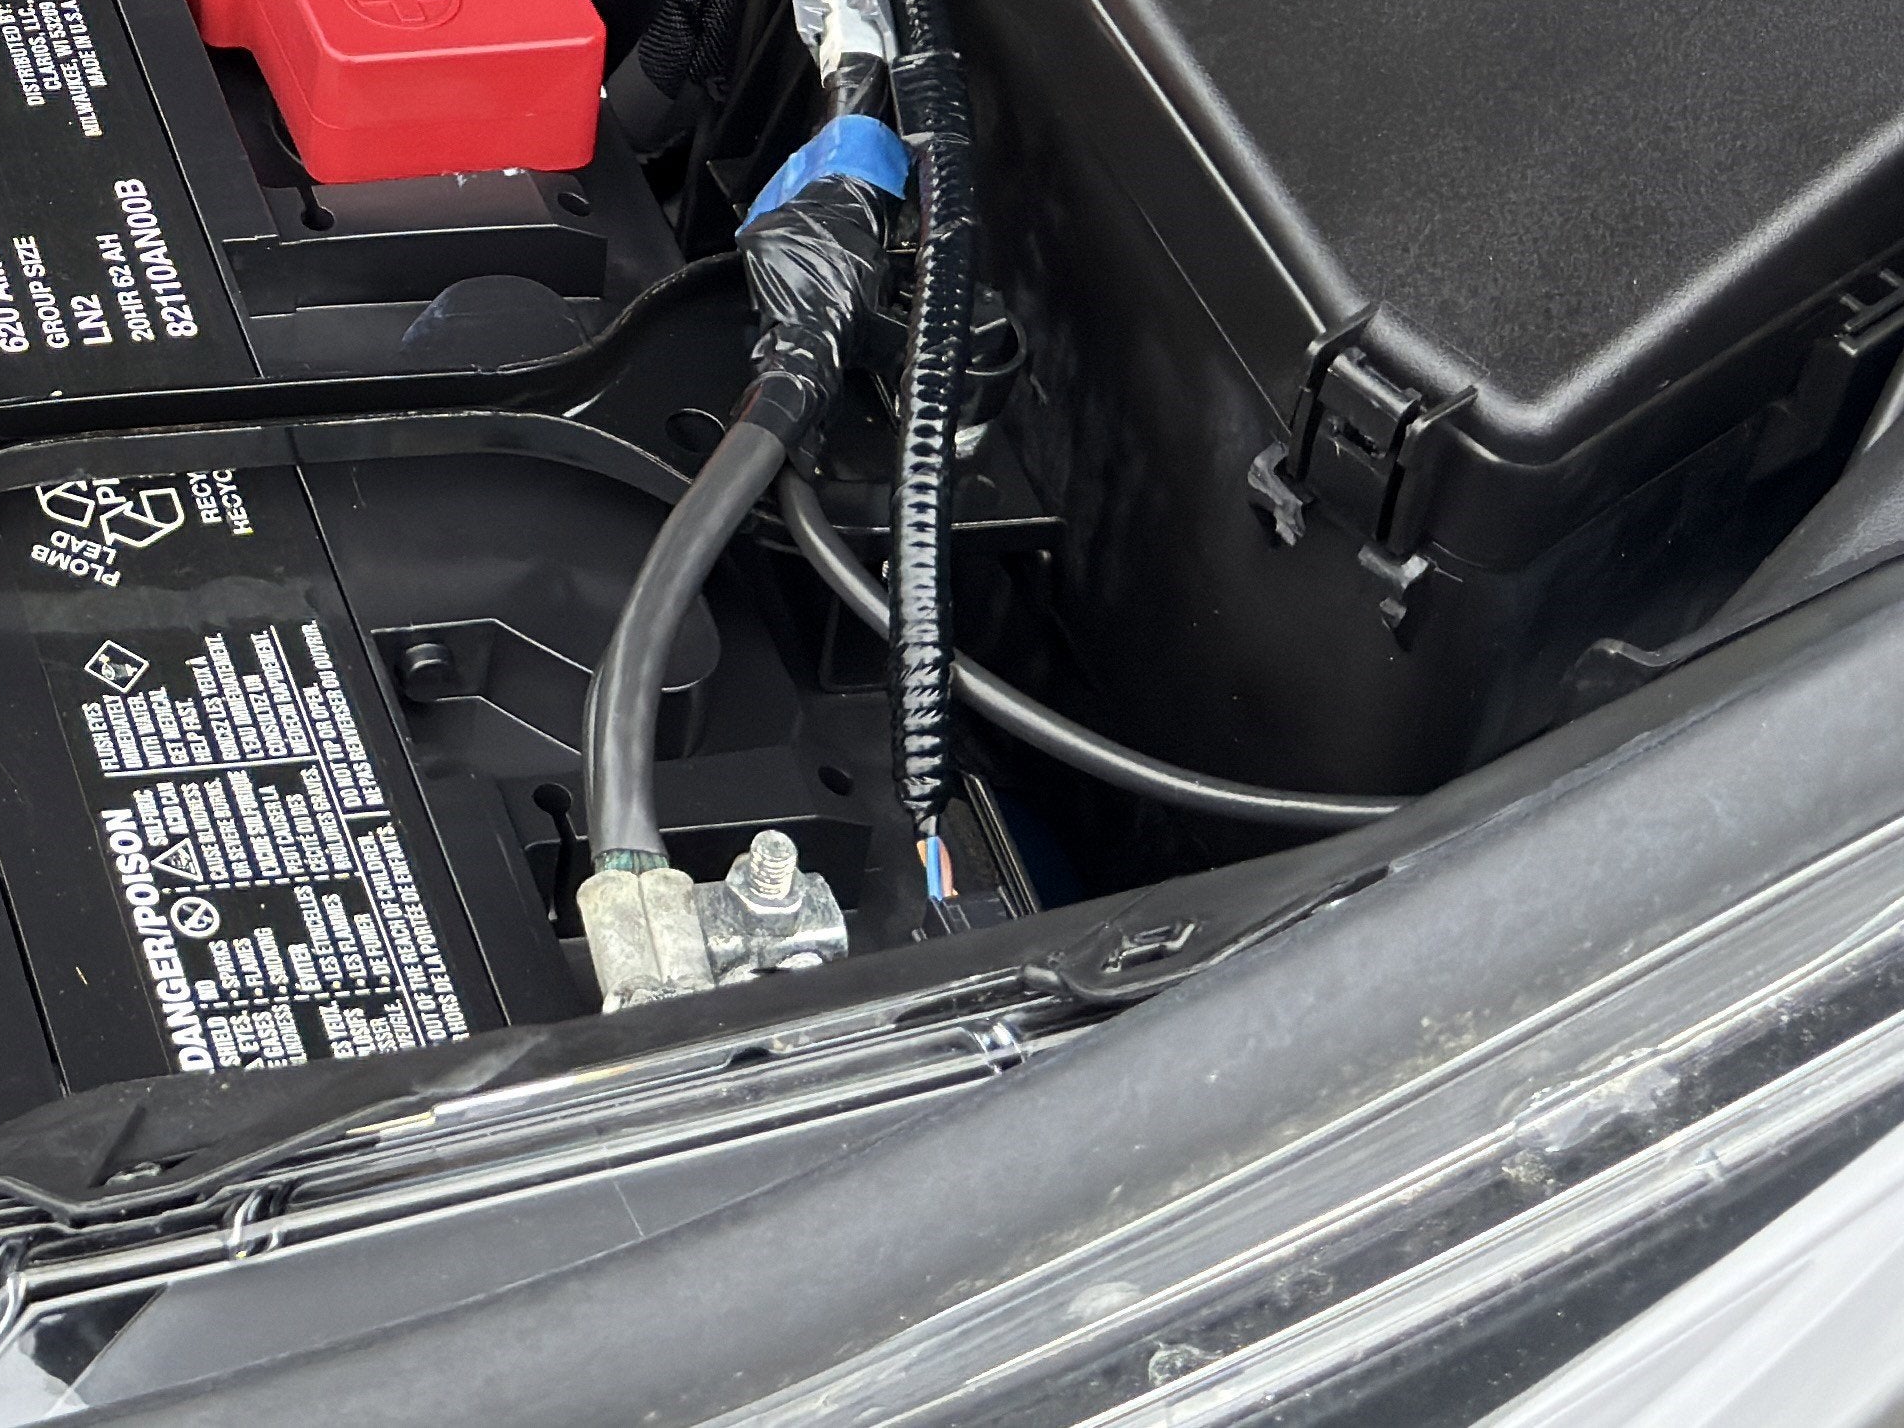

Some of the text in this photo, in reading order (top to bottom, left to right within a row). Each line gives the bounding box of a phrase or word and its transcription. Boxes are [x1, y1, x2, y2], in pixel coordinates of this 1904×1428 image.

[2, 25, 46, 106] DISTRIBUTED
[28, 32, 62, 90] CLARIOS,
[38, 1, 104, 137] MILWAUKEE, WI 53209
[72, 35, 93, 49] IN
[78, 50, 108, 87] MADE
[114, 177, 199, 337] 82110AN00B
[12, 235, 70, 349] GROUP SIZE
[96, 233, 156, 342] 20HR 62 AH
[71, 294, 113, 346] LN2
[30, 544, 122, 588] PLOMB
[50, 529, 117, 565] LEAD
[193, 664, 218, 696] YEUX
[250, 630, 292, 703] RAPIDEMENT.
[82, 702, 119, 770] FLUSH EYES
[102, 694, 143, 769] IMMEDIATELY
[127, 692, 167, 767] WITH WATER.
[149, 687, 189, 765] GET MEDICAL
[175, 697, 212, 763] HELP FAST.
[203, 696, 227, 719] LES
[242, 674, 287, 757] CONSULTEZ UN
[301, 619, 385, 807] NE PAS RENVERSER OU OUVRIR.
[212, 719, 242, 761] RINCEZ
[302, 682, 362, 808] DO NOT TIP OR OPEN.
[156, 782, 189, 835] ACID CAN
[227, 769, 267, 835] SULFURIQUE
[286, 794, 307, 817] DES
[301, 765, 331, 812] GRAVES.
[133, 789, 168, 846] SULFURIC
[181, 782, 229, 881] CAUSE BLINDNESS
[204, 777, 252, 879] OR SEVERE BURNS.
[259, 785, 305, 874] PEUT CAUSER LA
[295, 817, 314, 833] OU
[377, 822, 413, 884] ENFANTS.
[398, 884, 420, 902] DE
[101, 809, 214, 1072] DANGER/POISON
[233, 938, 265, 986] FLAMES
[254, 927, 289, 985] SMOKING
[322, 893, 367, 978] LES FLAMMES
[354, 913, 391, 976] DE FUMER
[358, 831, 447, 1041] OUT OF THE REACH OF CHILDREN.
[194, 979, 219, 1001] NO
[208, 939, 240, 990] SPARKS
[318, 957, 343, 981] LES
[424, 954, 446, 975] LA
[431, 975, 453, 993] DE
[206, 1016, 240, 1067] SHIELD
[230, 1011, 259, 1053] EYES.
[252, 1011, 284, 1058] GASES
[319, 1000, 347, 1041] YEUX.
[439, 994, 469, 1033] HORS
